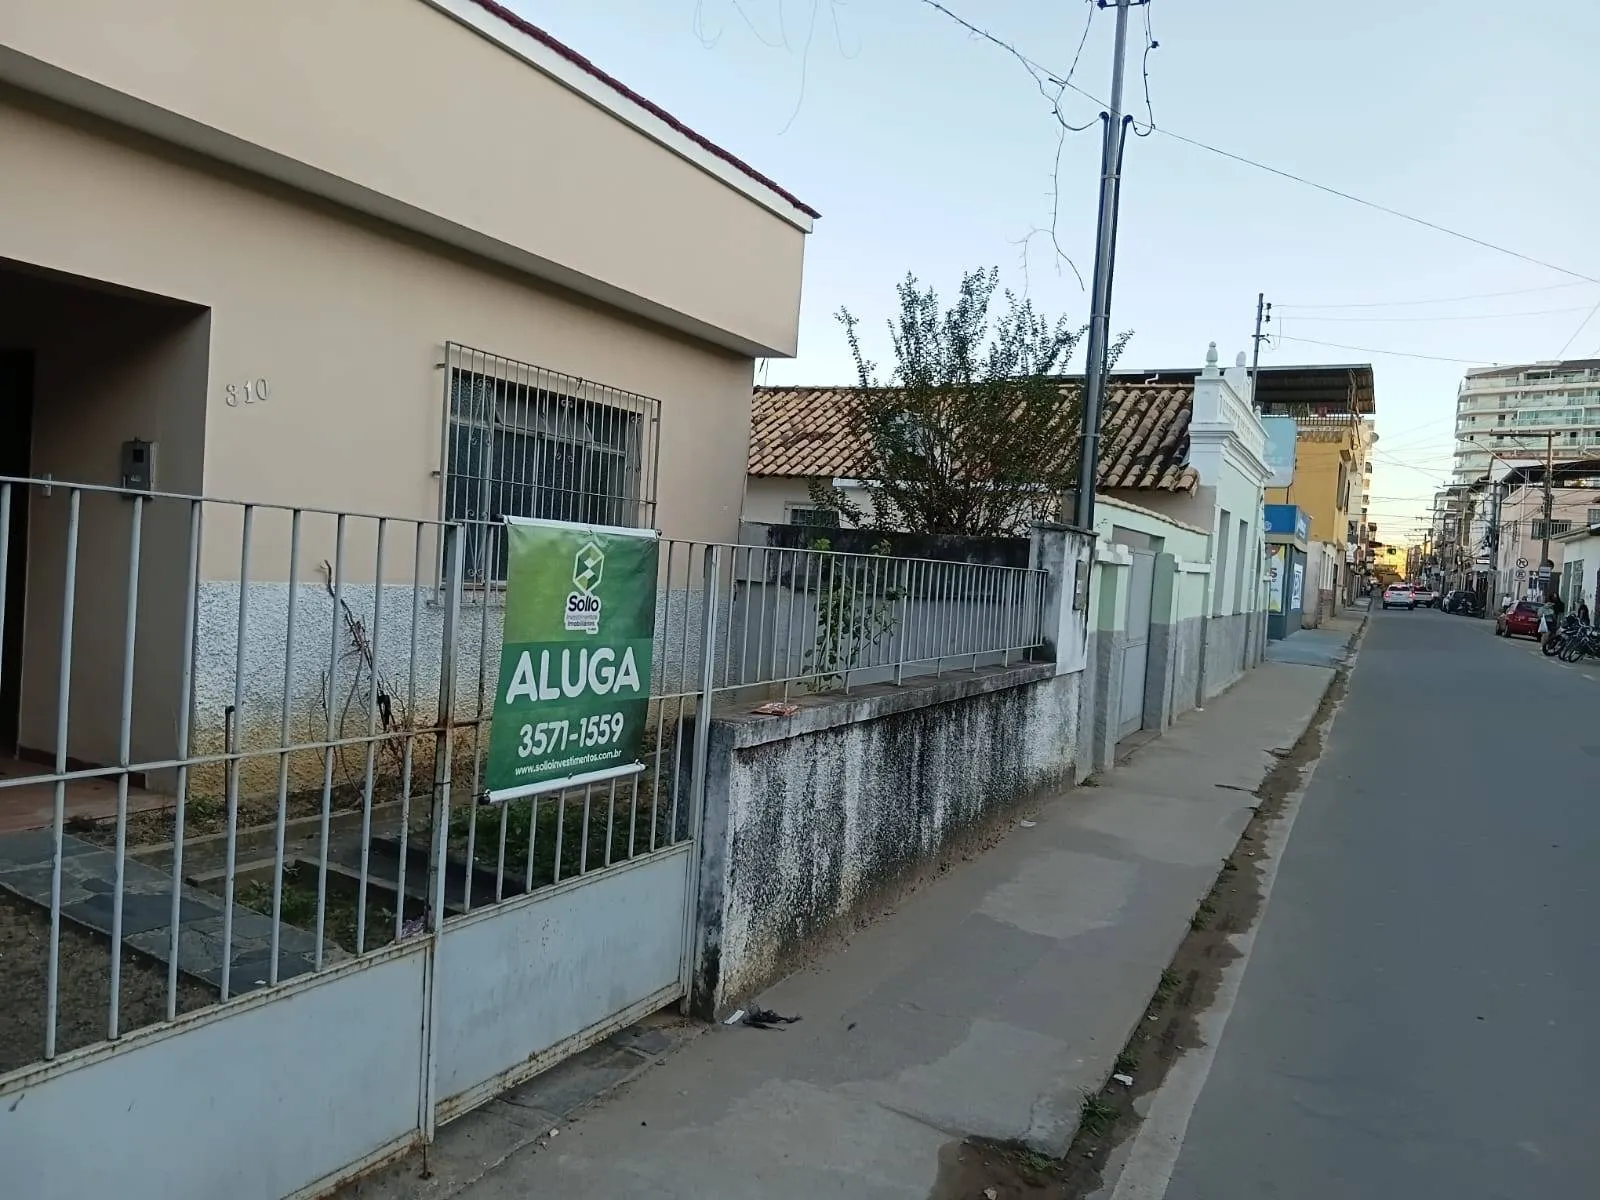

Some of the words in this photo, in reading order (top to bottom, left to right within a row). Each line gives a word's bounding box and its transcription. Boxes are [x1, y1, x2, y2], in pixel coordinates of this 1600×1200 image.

[568, 595, 599, 612] Sollo
[506, 647, 640, 705] ALUGA
[518, 712, 625, 758] 3571-1559
